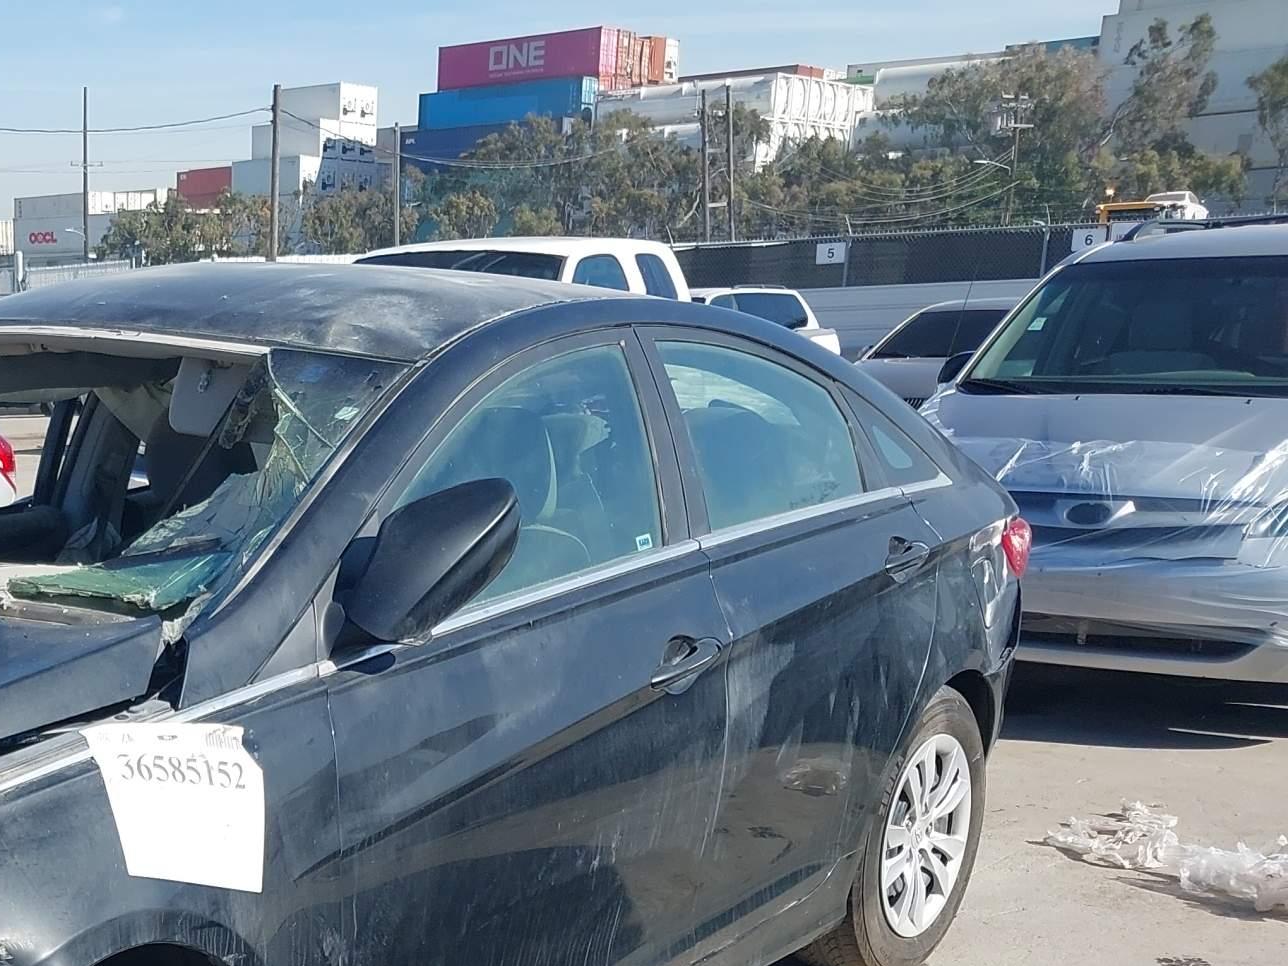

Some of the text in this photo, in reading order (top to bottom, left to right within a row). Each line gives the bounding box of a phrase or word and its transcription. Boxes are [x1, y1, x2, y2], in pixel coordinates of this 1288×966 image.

[488, 41, 545, 70] ONE
[28, 231, 58, 244] OOCL
[1084, 234, 1094, 246] 6
[827, 247, 836, 259] 5
[117, 753, 246, 790] 36585152
